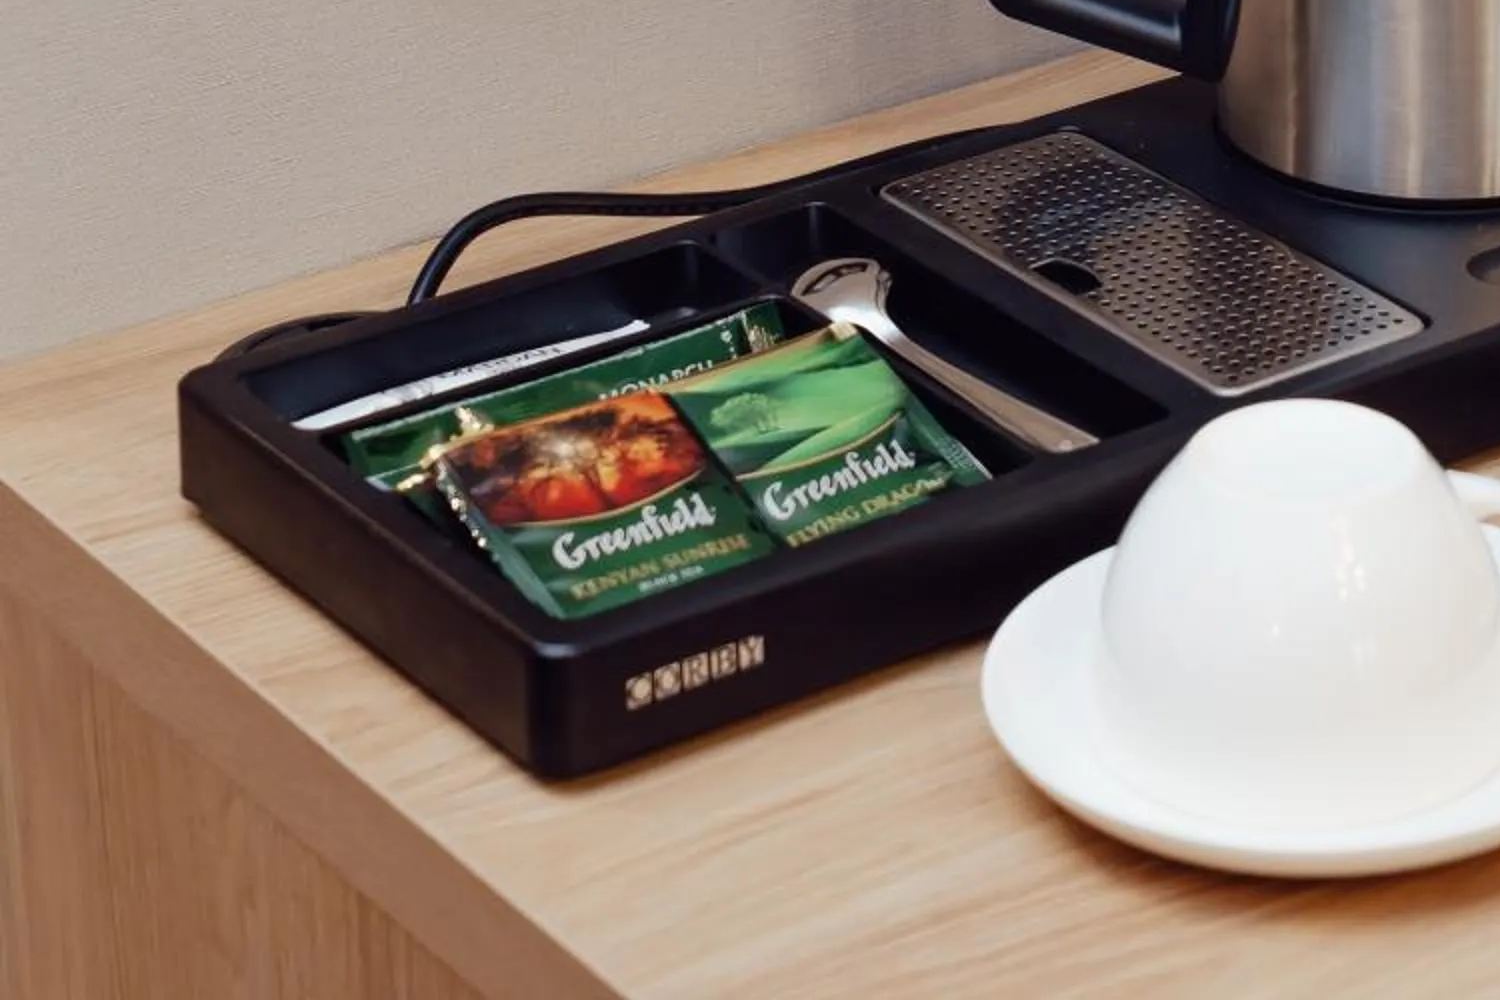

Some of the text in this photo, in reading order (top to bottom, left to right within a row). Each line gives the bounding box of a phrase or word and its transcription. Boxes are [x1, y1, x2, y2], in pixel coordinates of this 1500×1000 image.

[763, 438, 915, 521] Greenfield
[552, 491, 716, 570] Greenfield
[786, 505, 861, 548] FLYING
[569, 533, 750, 601] KENYAN SUNRISE
[625, 634, 765, 711] CORBY
